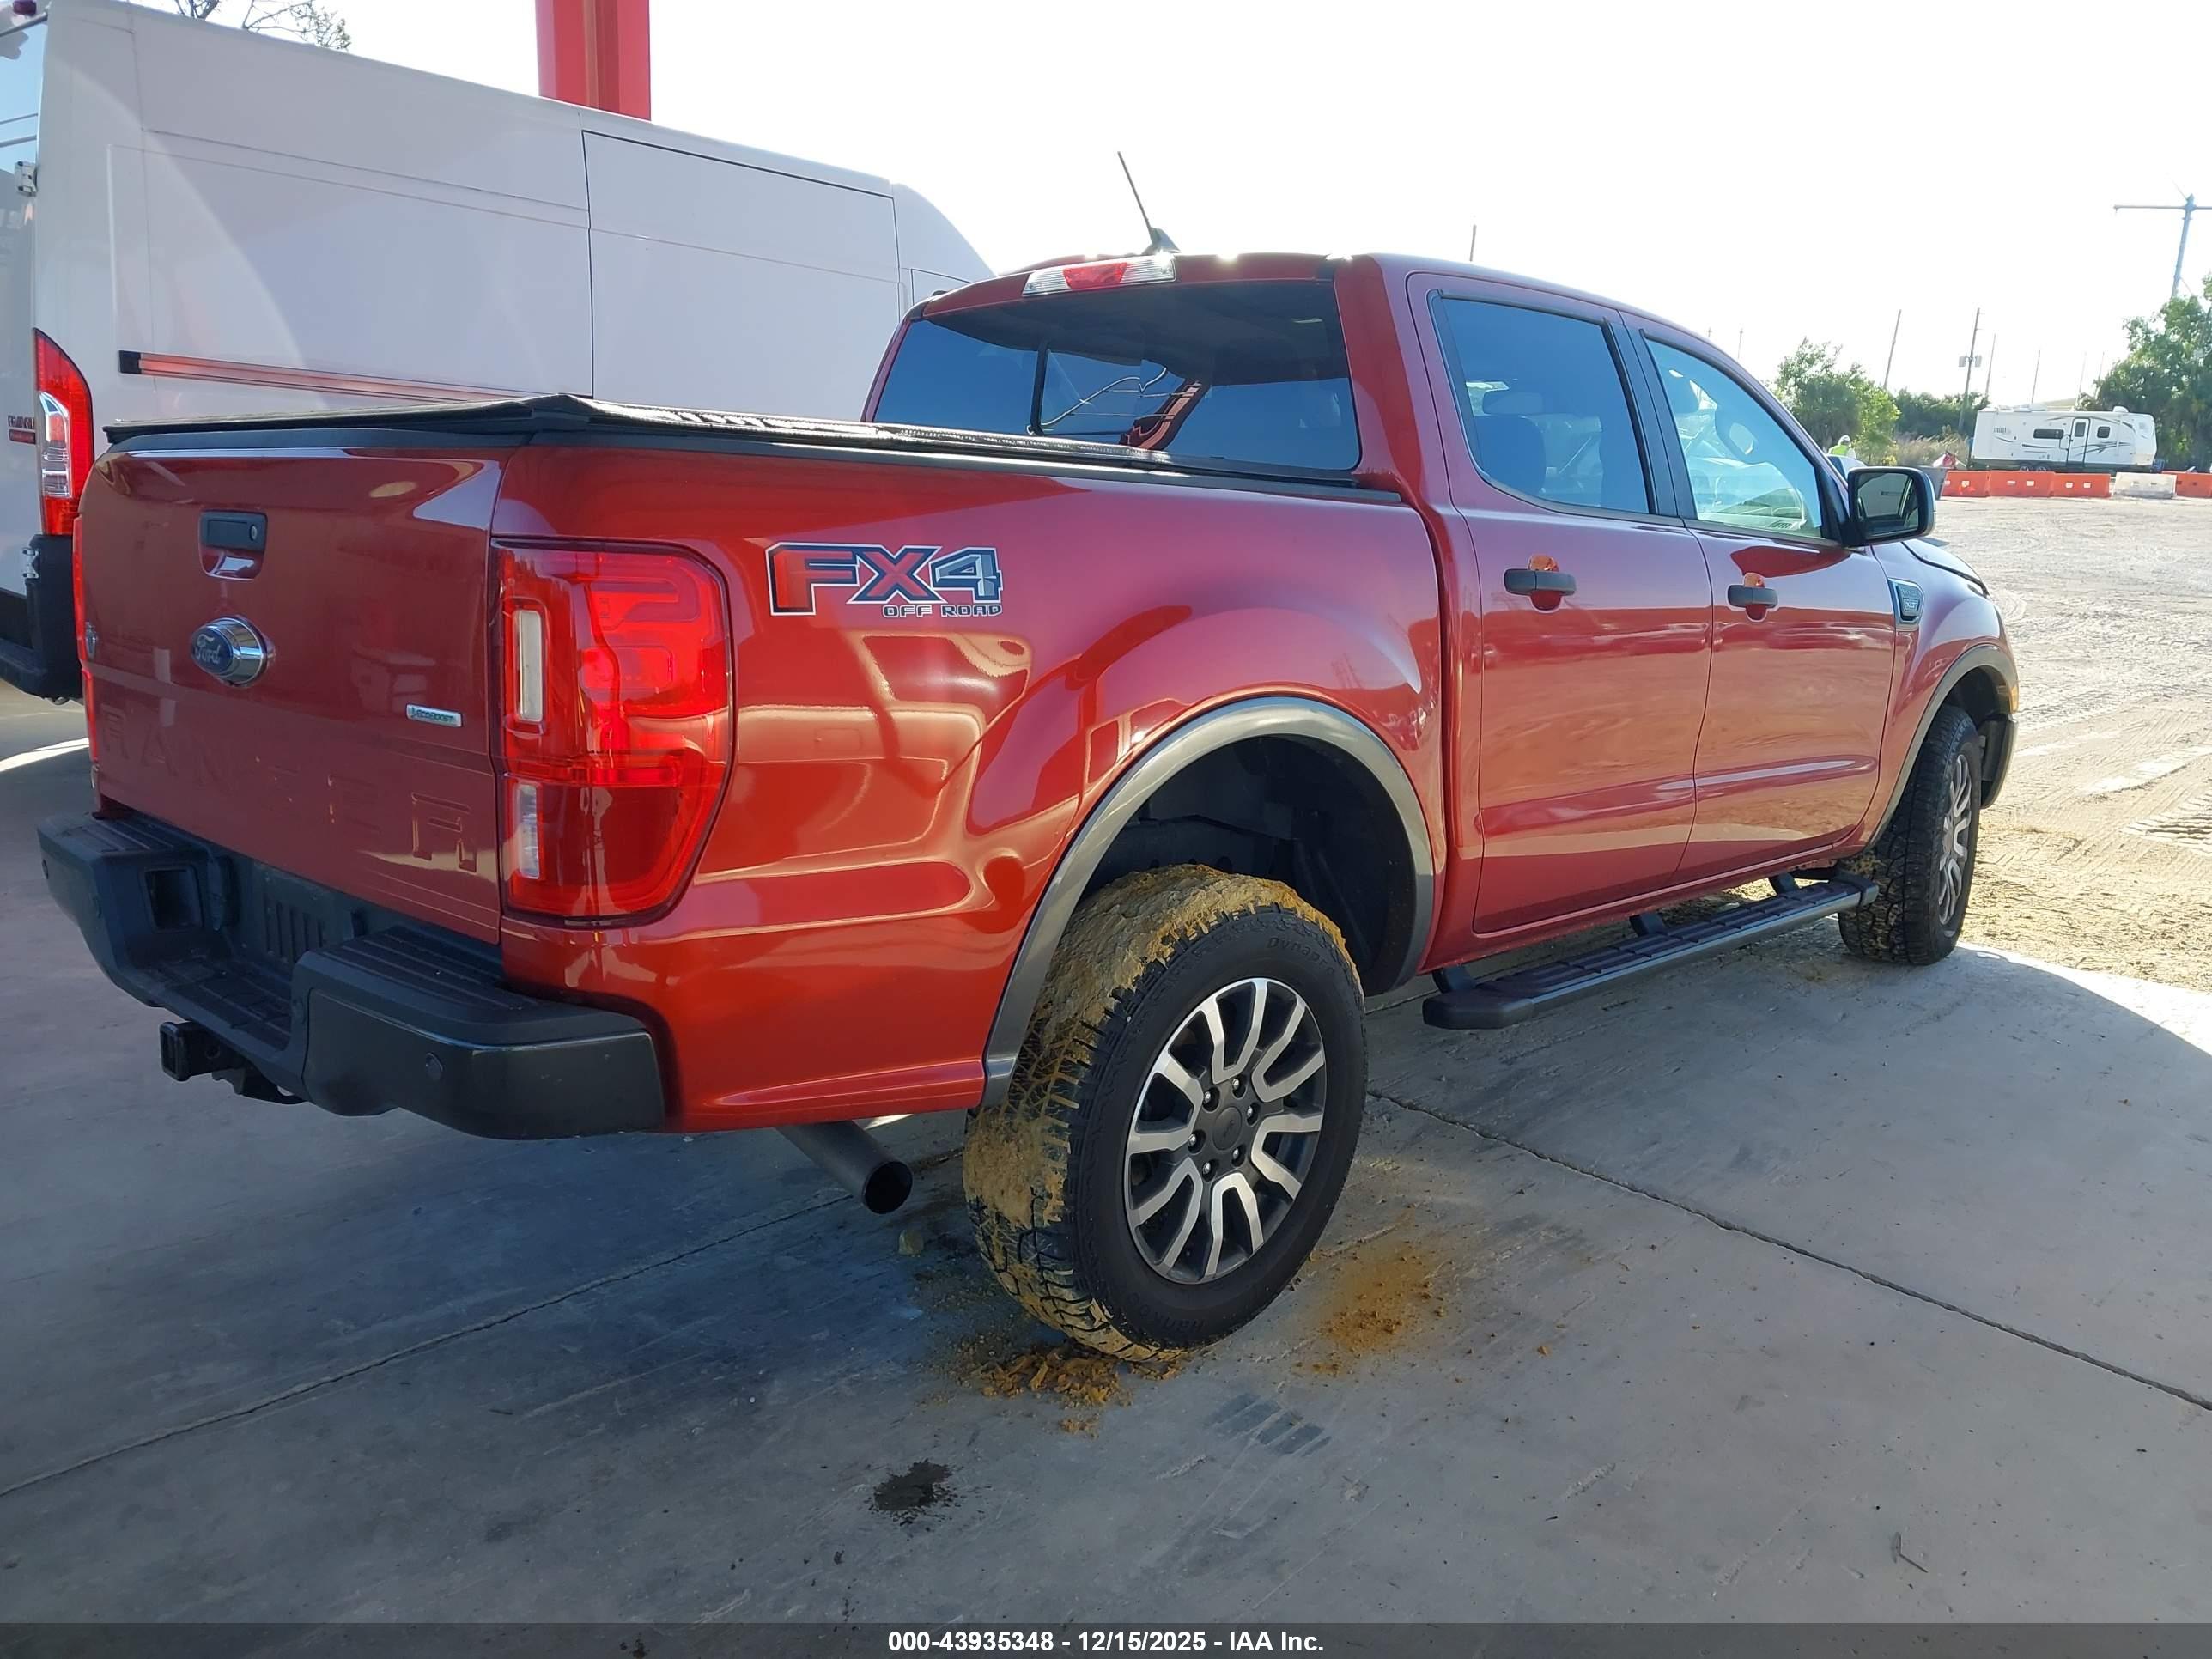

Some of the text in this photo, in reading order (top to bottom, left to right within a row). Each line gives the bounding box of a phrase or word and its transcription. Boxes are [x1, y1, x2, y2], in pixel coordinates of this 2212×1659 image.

[765, 542, 1004, 616] FX4
[882, 604, 1003, 618] OFF ROAD
[194, 634, 221, 665] Ford
[100, 702, 478, 873] RANER
